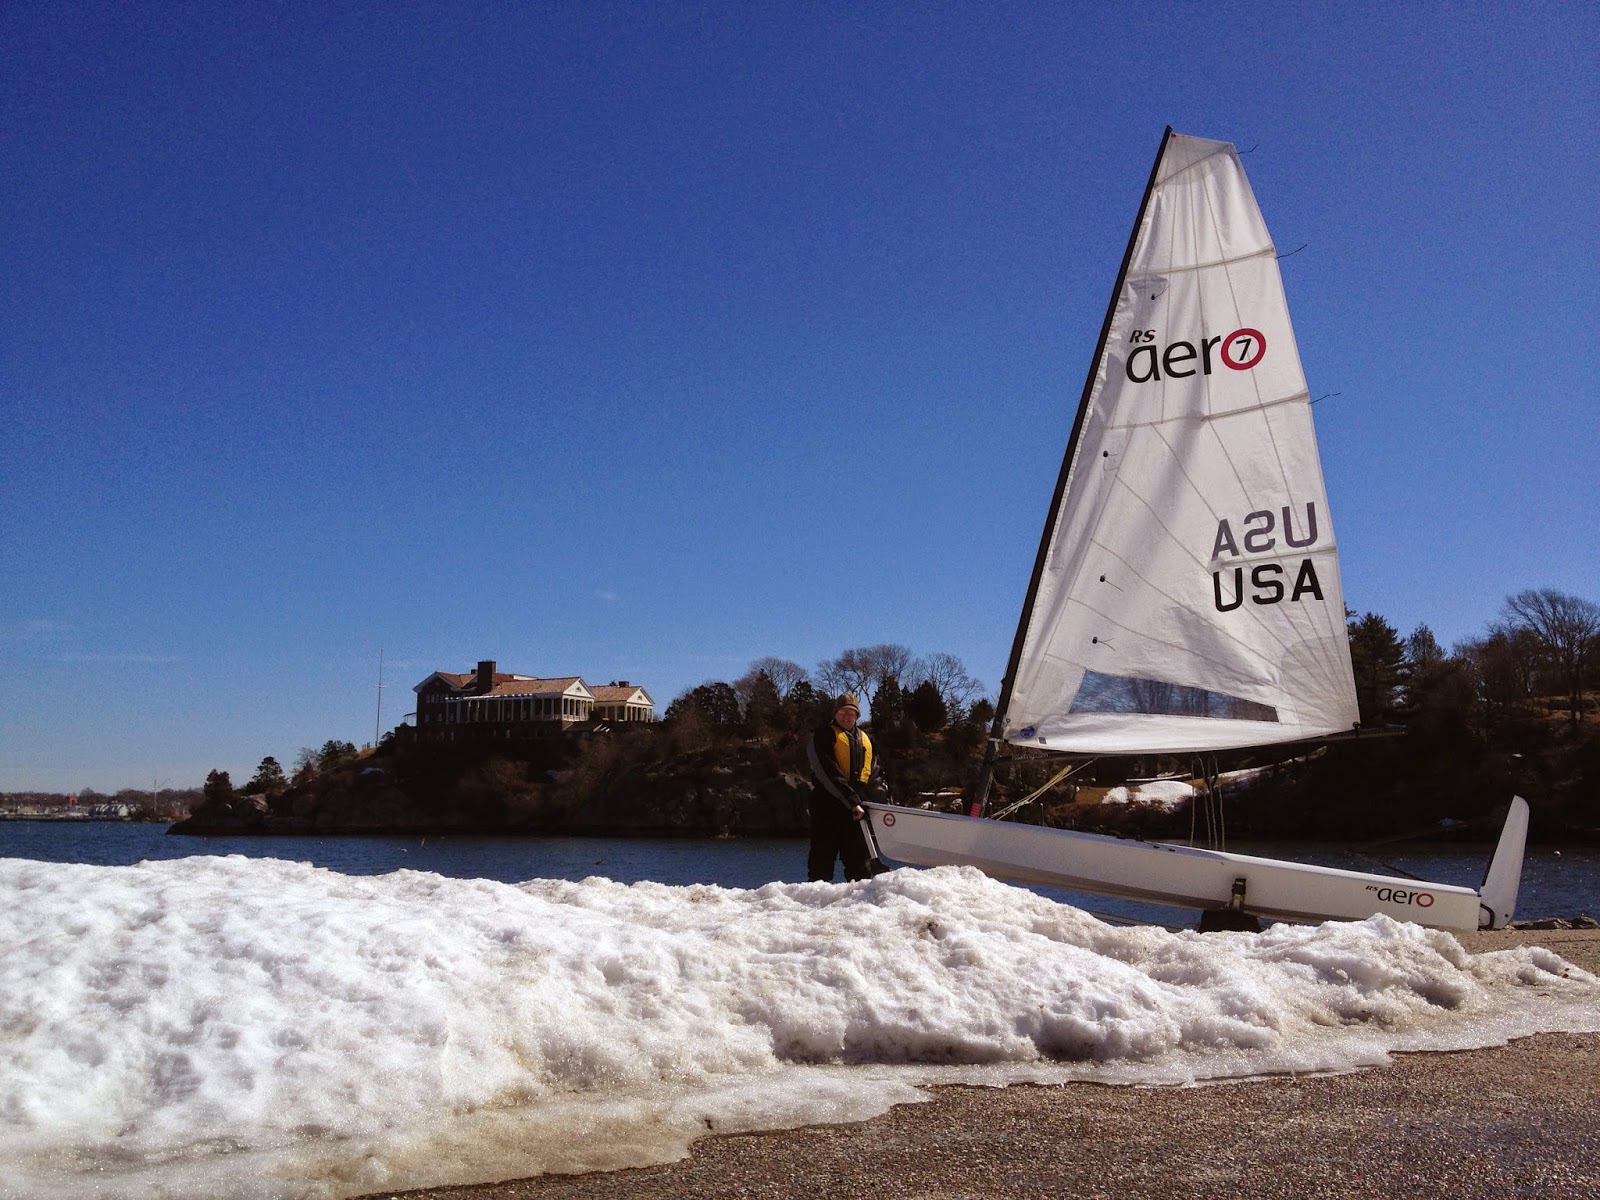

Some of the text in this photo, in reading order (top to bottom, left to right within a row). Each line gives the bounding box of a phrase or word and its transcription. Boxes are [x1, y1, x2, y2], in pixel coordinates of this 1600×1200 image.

[1129, 329, 1156, 343] RS
[1126, 328, 1267, 384] aero
[1235, 338, 1252, 362] 7
[1213, 558, 1324, 613] USA
[1377, 887, 1435, 908] aero
